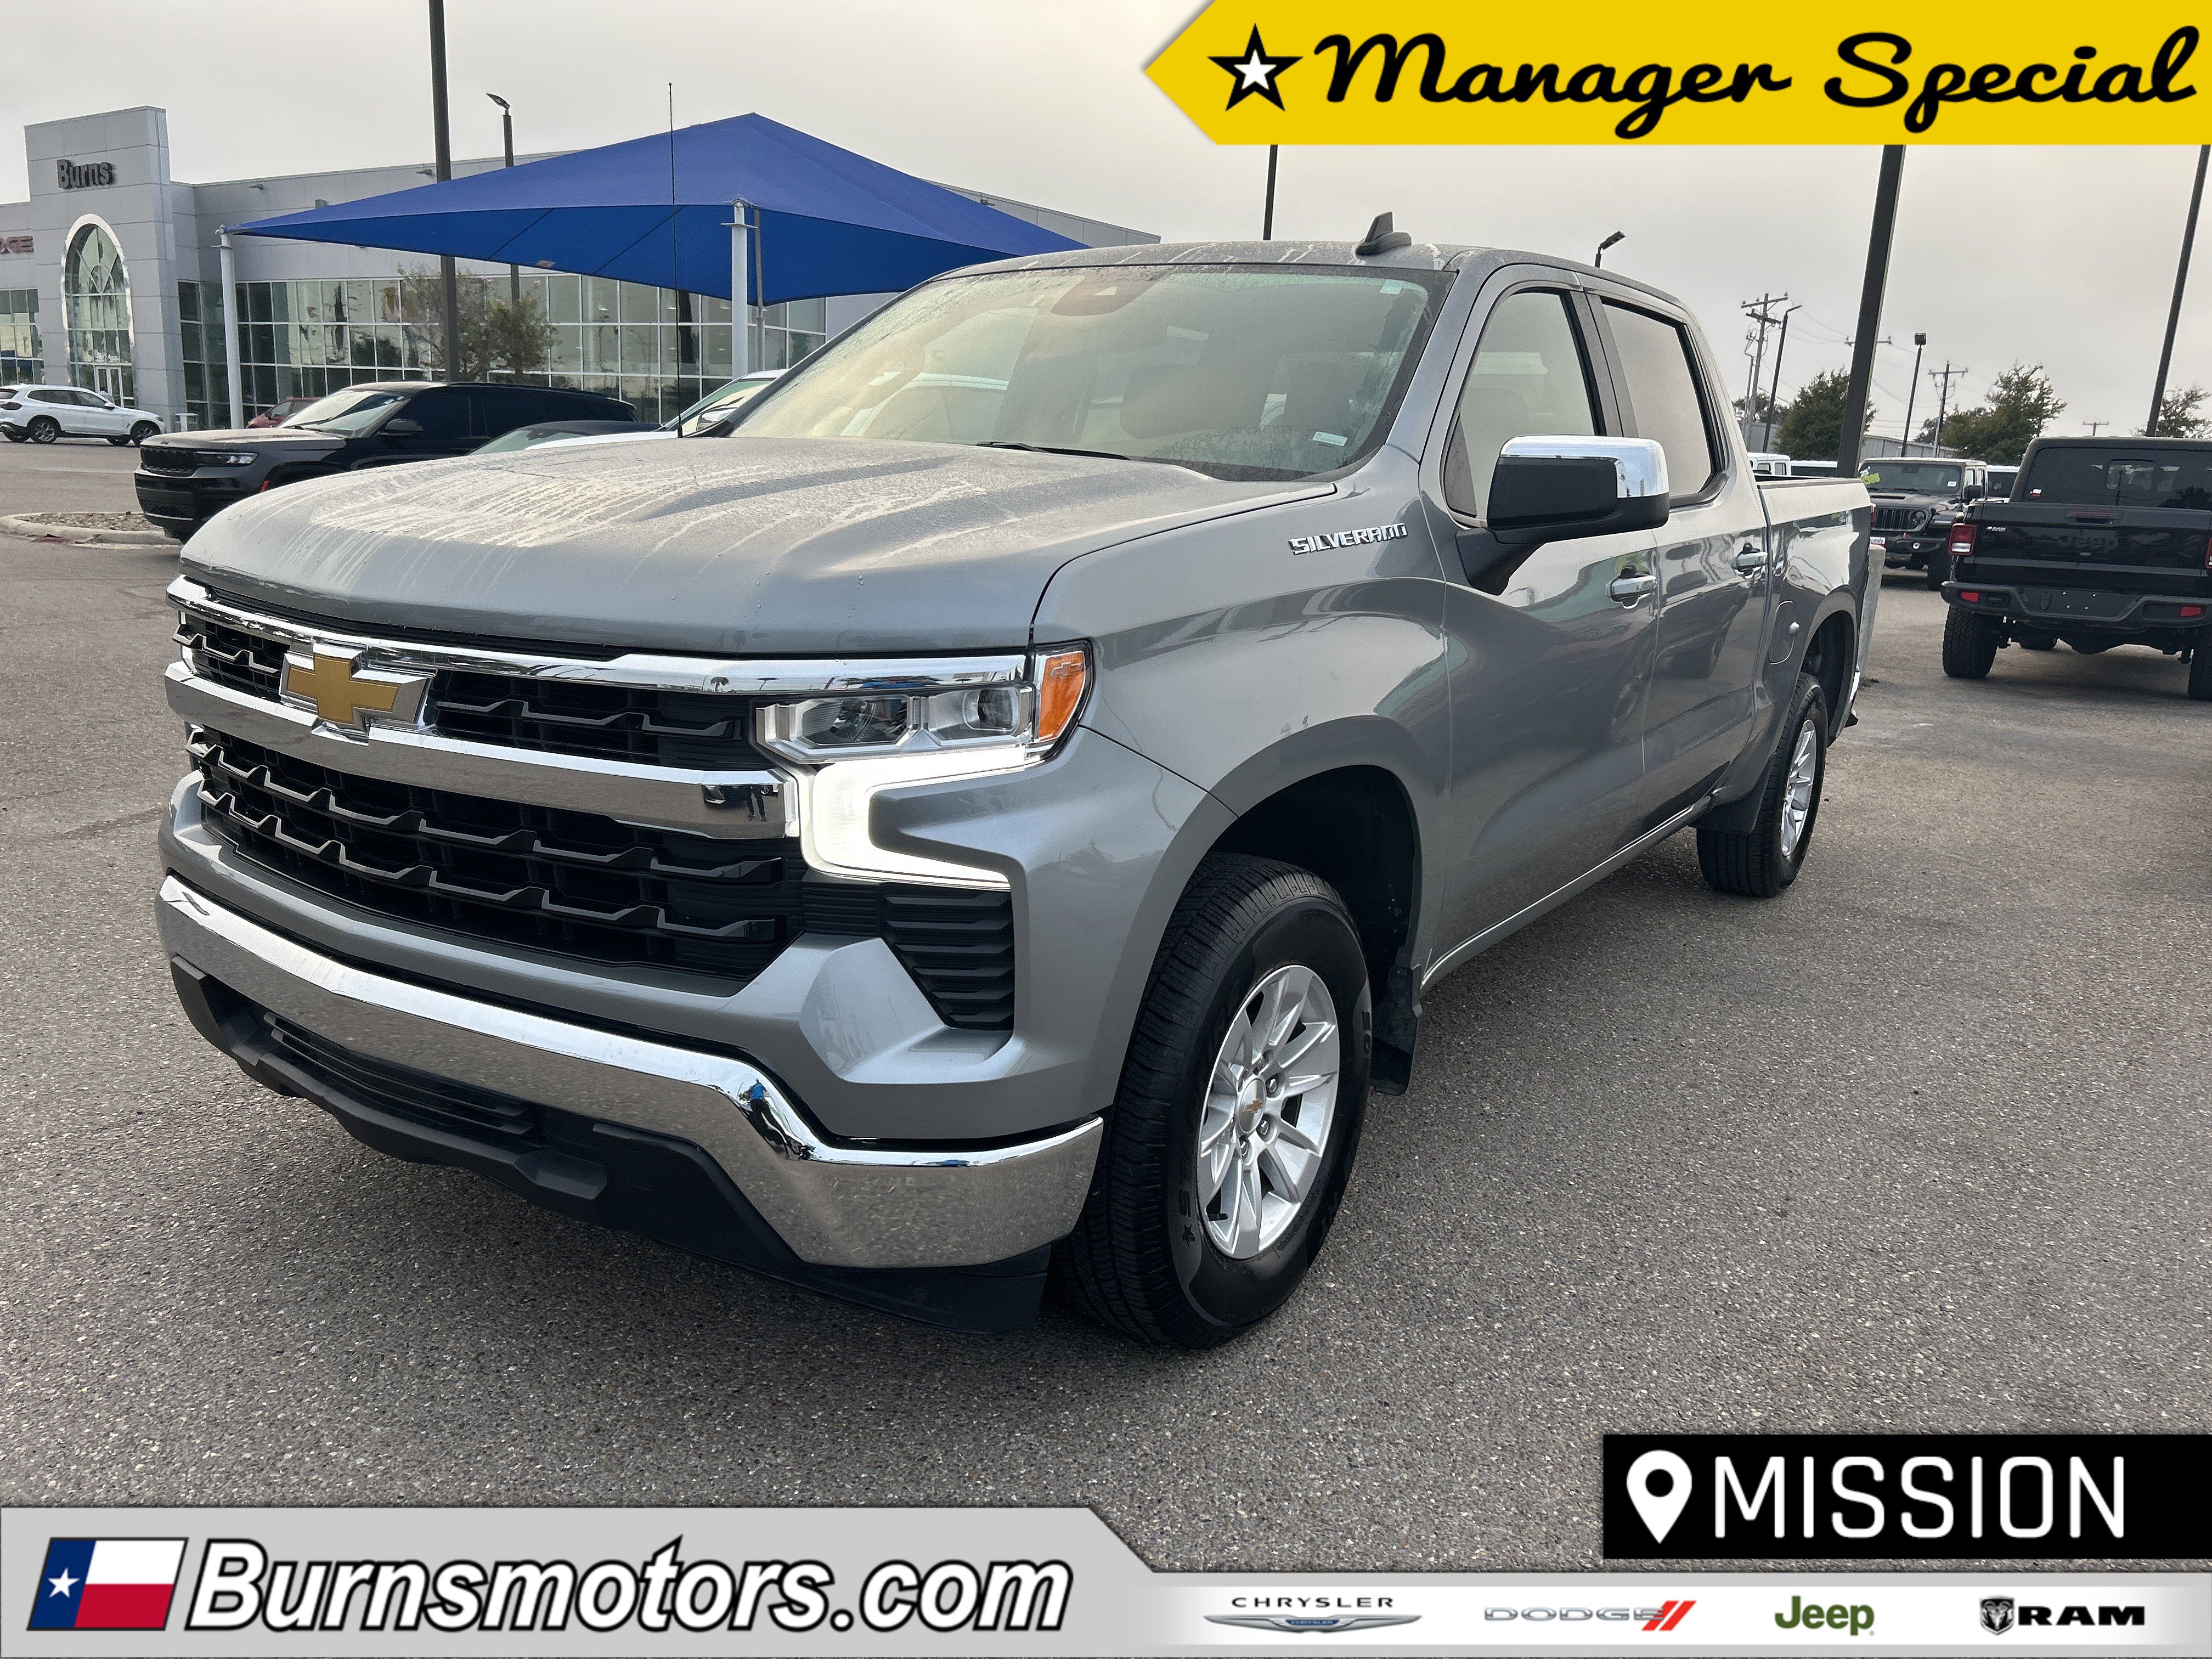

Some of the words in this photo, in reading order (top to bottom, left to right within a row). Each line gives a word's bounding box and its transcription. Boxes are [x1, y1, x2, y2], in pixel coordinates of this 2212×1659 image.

[57, 159, 112, 189] Burns
[1289, 523, 1409, 555] SILVERADO
[2058, 533, 2120, 553] Jeep
